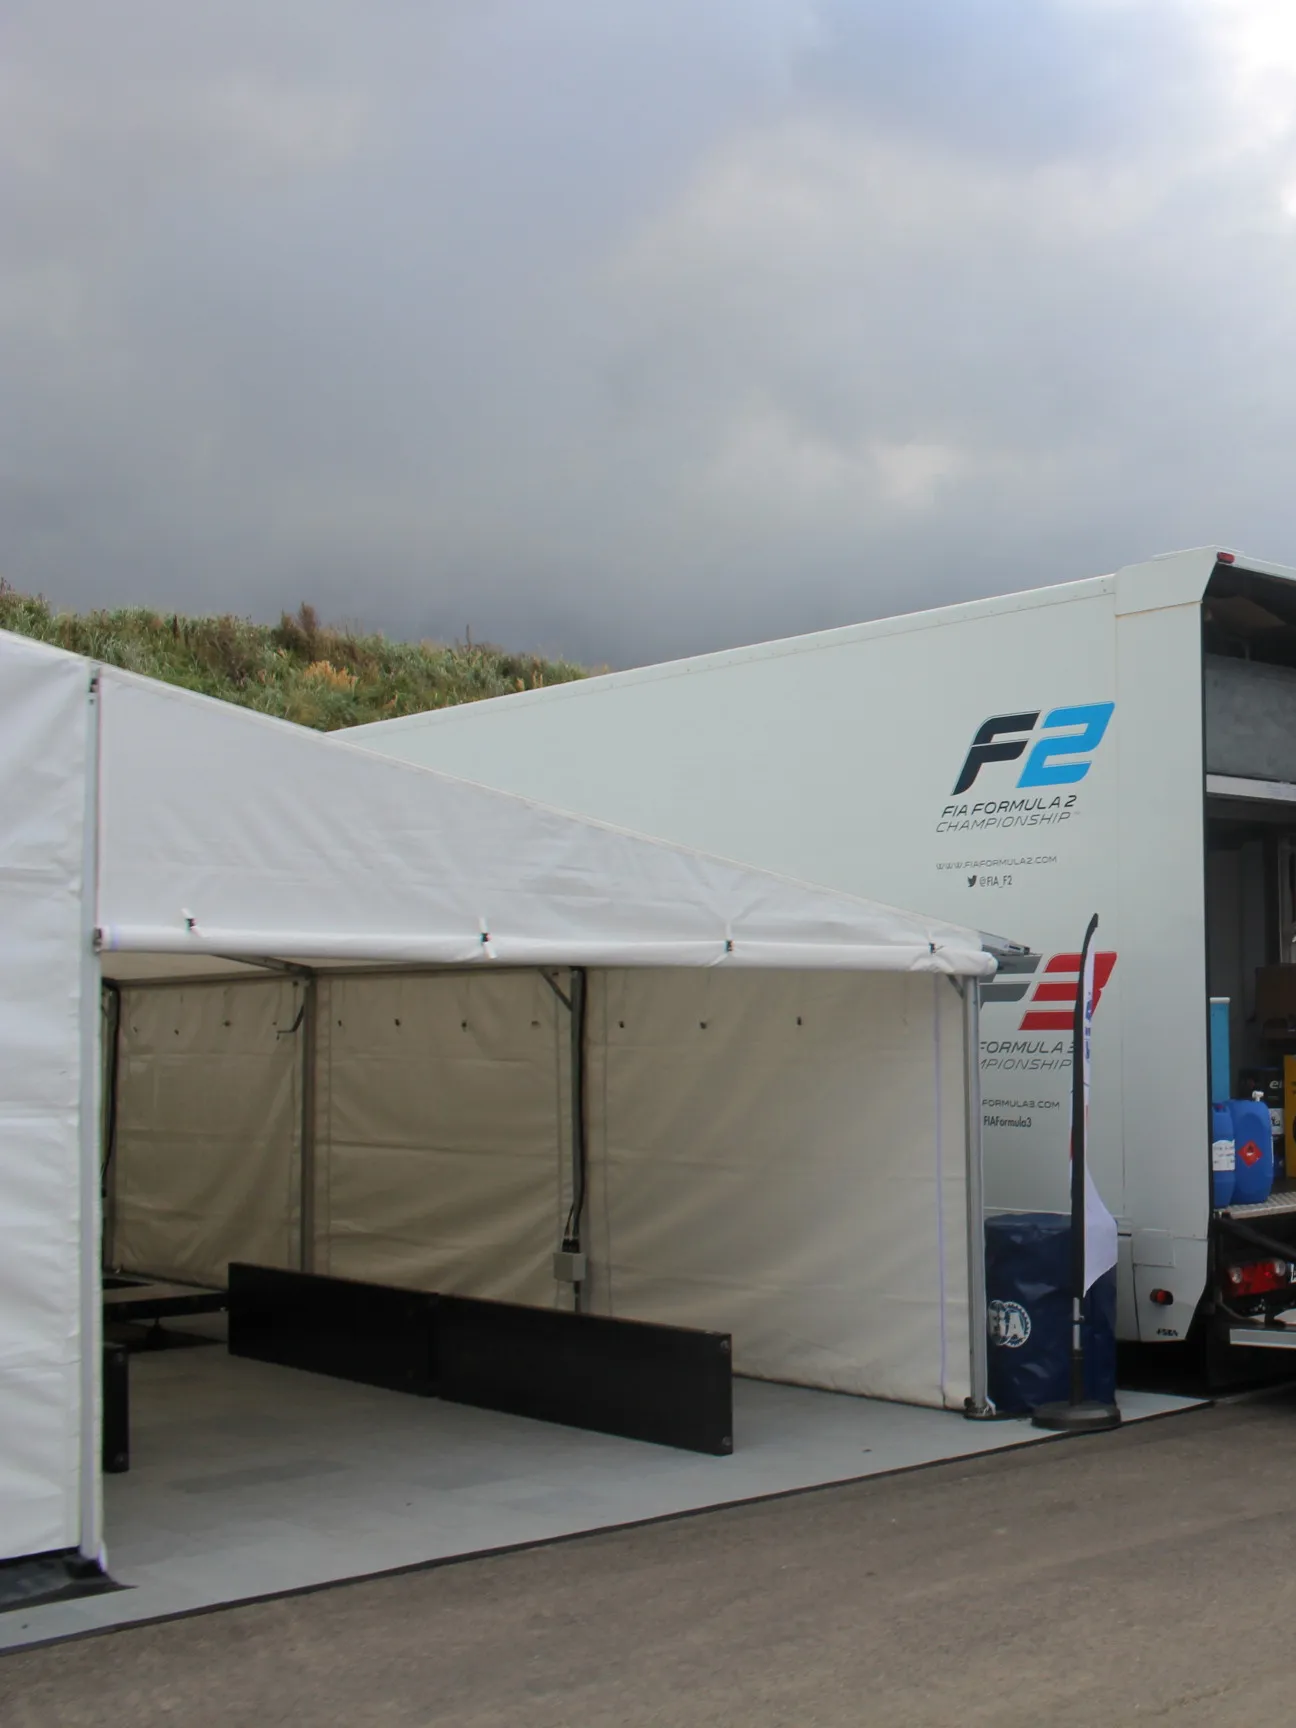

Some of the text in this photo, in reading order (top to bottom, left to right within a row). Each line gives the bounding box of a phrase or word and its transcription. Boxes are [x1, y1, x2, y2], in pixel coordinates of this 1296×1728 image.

[950, 701, 1115, 796] F2
[941, 795, 1077, 818] FIA FORMULA 2
[935, 812, 1073, 833] CHAMPIONSHIP
[936, 856, 1057, 870] WWW.FIAFORMULA2.COM
